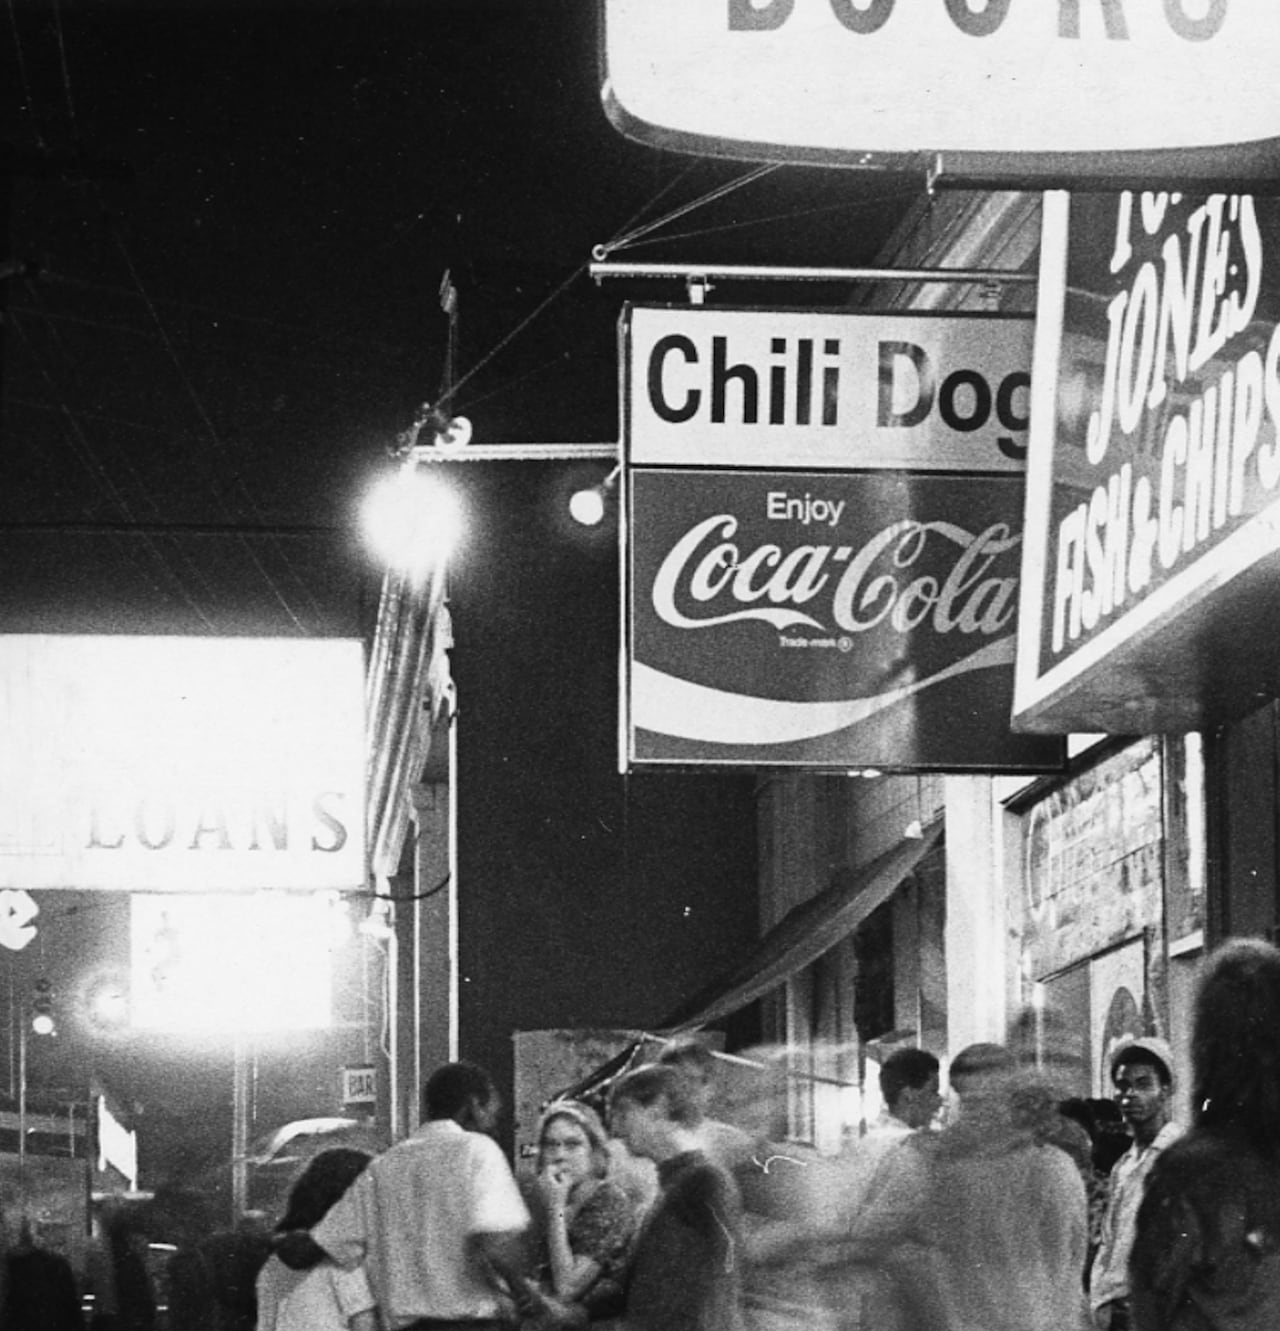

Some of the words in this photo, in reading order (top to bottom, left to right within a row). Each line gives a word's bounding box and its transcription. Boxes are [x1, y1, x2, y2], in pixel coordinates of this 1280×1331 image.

[646, 333, 841, 427] Chili
[766, 491, 844, 526] Enjoy
[651, 514, 1020, 634] Coca-Cola
[85, 790, 350, 854] LOANS
